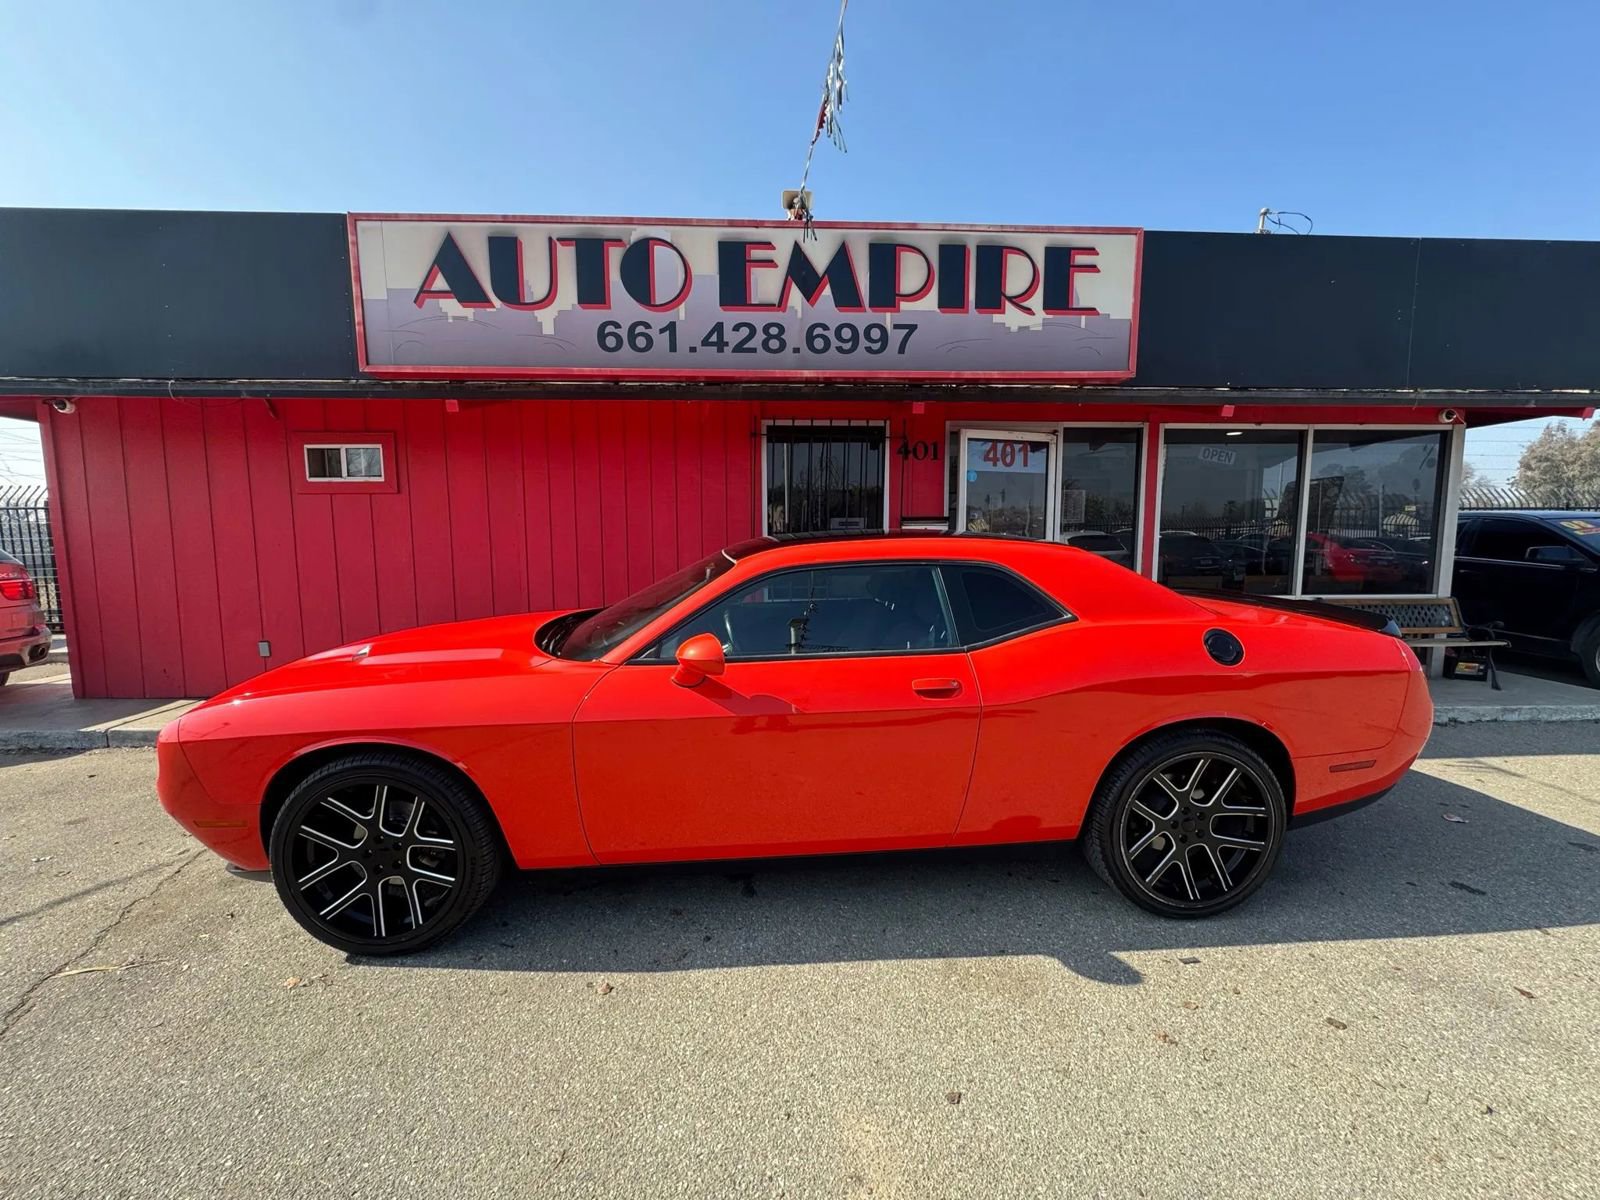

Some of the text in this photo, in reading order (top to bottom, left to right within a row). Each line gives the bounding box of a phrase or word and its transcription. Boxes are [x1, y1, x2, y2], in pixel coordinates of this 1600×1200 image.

[413, 231, 1101, 316] AUTO EMPIRE
[596, 320, 919, 355] 661.428.6997
[897, 440, 939, 461] 401
[982, 440, 1030, 468] 401
[1202, 448, 1233, 463] OPEN
